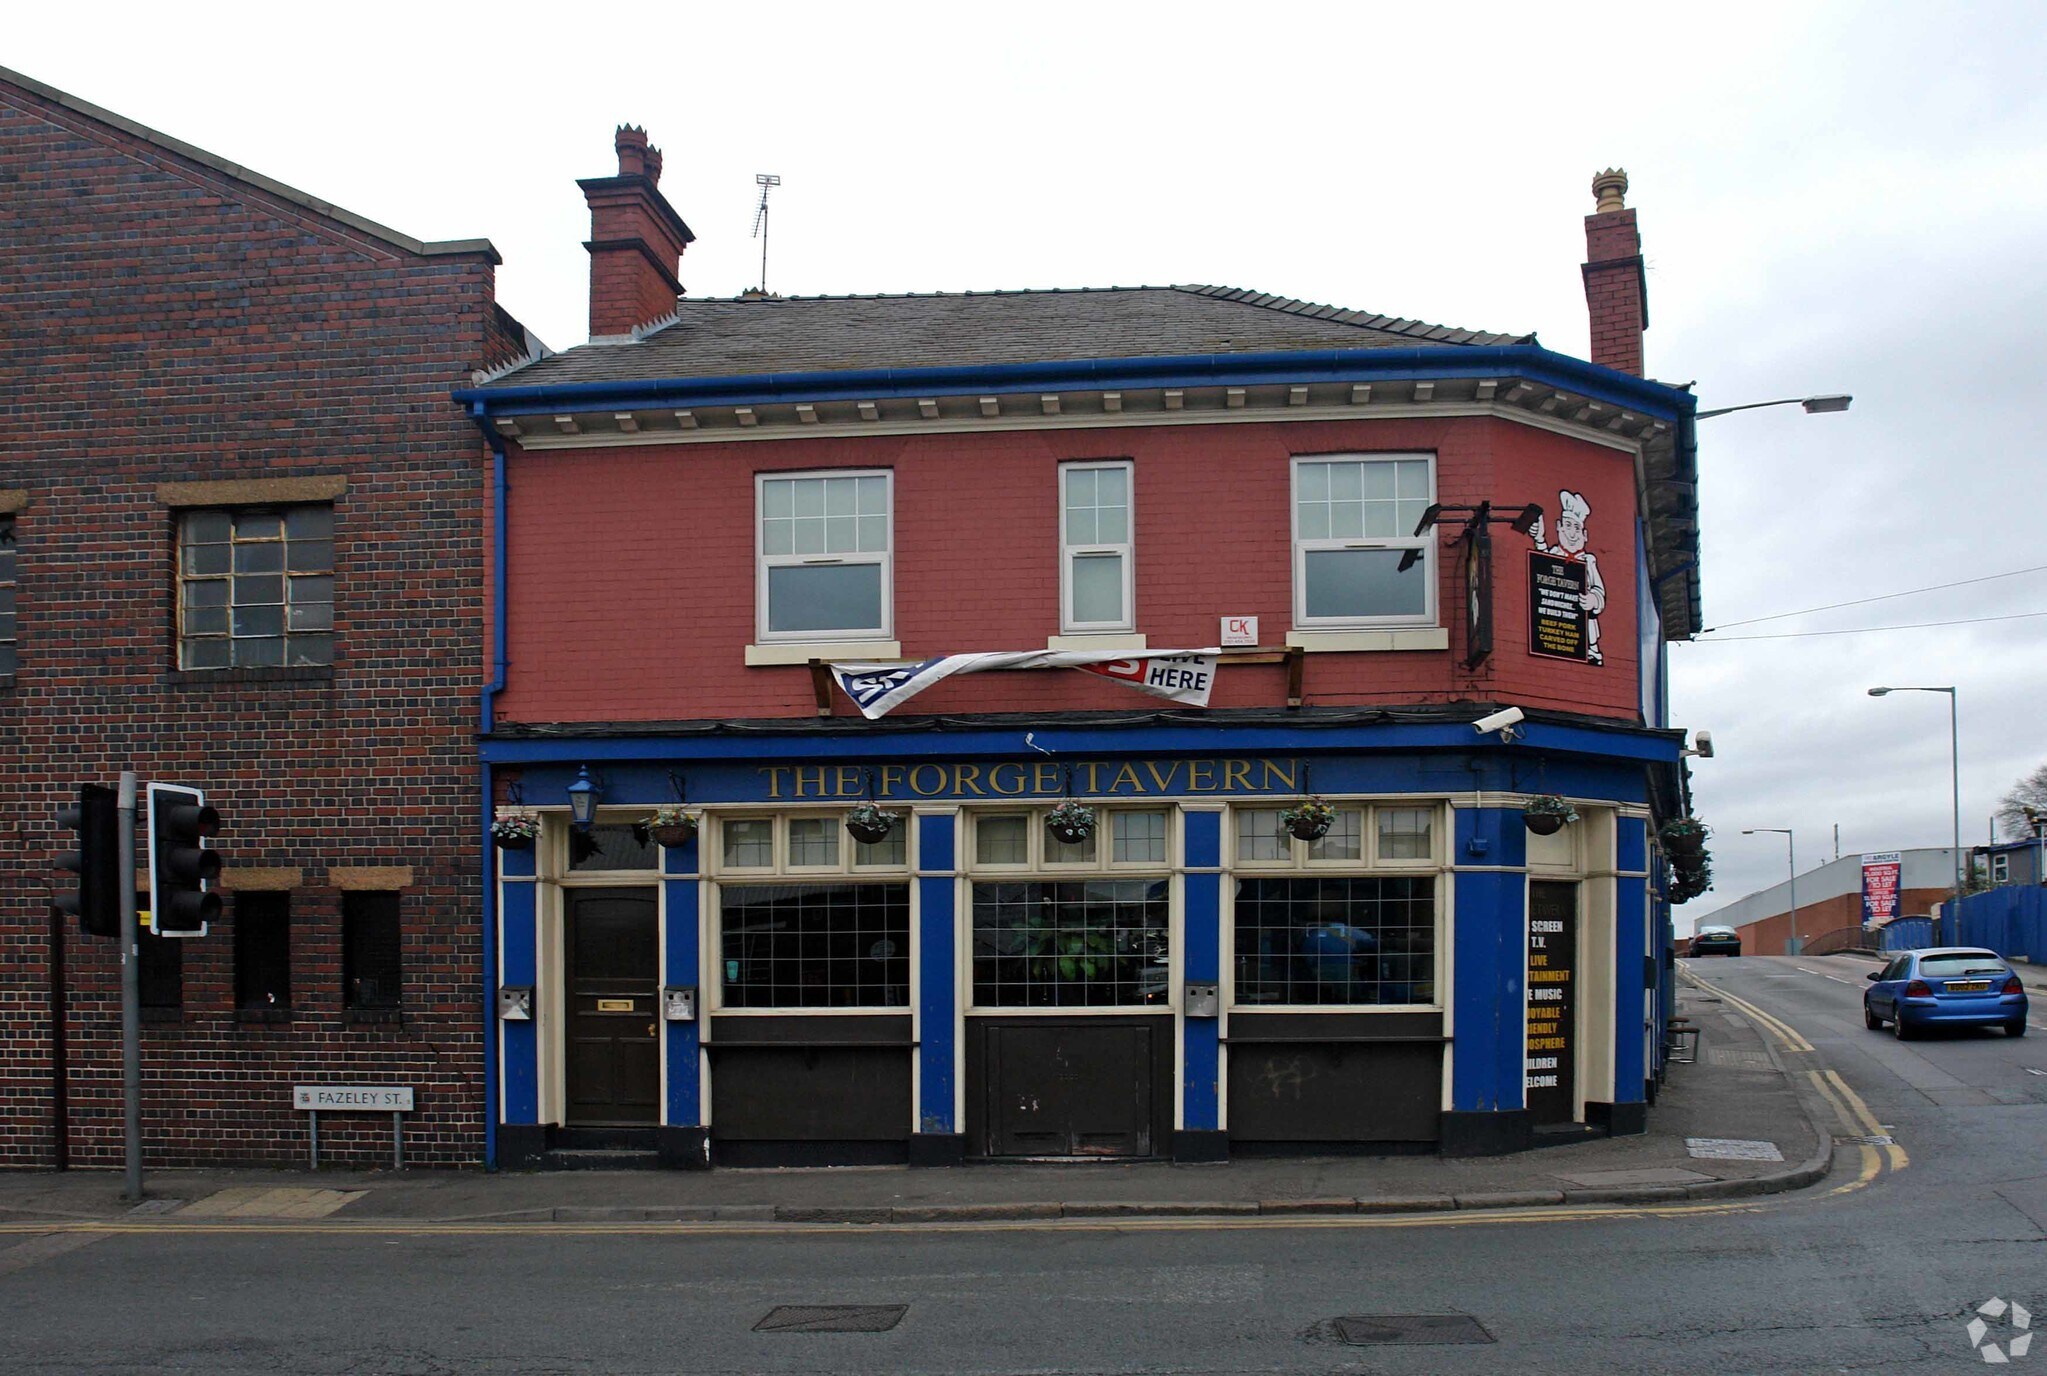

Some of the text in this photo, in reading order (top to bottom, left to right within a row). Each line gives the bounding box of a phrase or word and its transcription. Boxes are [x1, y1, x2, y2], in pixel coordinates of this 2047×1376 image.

[1230, 620, 1249, 635] CK
[1541, 619, 1576, 630] BEEF PORK
[1538, 626, 1580, 638] TURKEY HAM
[1539, 634, 1565, 644] CARVED
[1557, 645, 1575, 653] BONE
[1150, 668, 1207, 691] HERE
[758, 758, 1299, 798] THE FORGE TAVERN
[1531, 920, 1563, 932] SCREEN
[1531, 936, 1546, 948] T.V.
[1530, 954, 1548, 966] LIVE
[1528, 970, 1570, 981] TAINMENT
[1535, 988, 1563, 1000] MUSIC
[1527, 1038, 1565, 1049] OSPHERE
[1527, 1075, 1558, 1088] ELCOME
[318, 1092, 378, 1104] FAZELEY
[384, 1093, 402, 1104] ST.
